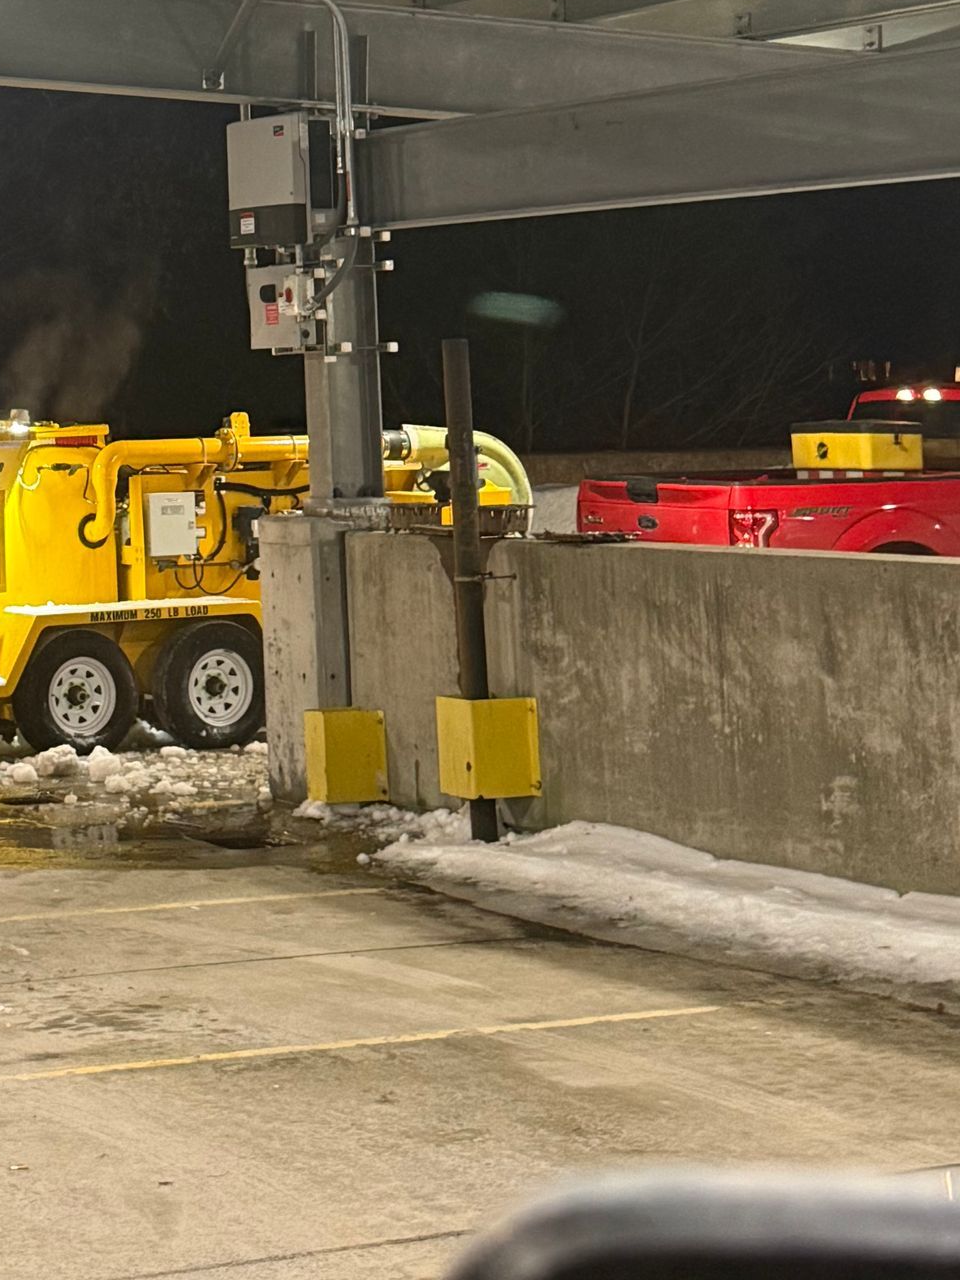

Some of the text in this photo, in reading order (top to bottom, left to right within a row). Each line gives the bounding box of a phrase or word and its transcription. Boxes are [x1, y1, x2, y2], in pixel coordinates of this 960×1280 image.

[90, 605, 209, 622] MAXIMUM 250 LB LOAD
